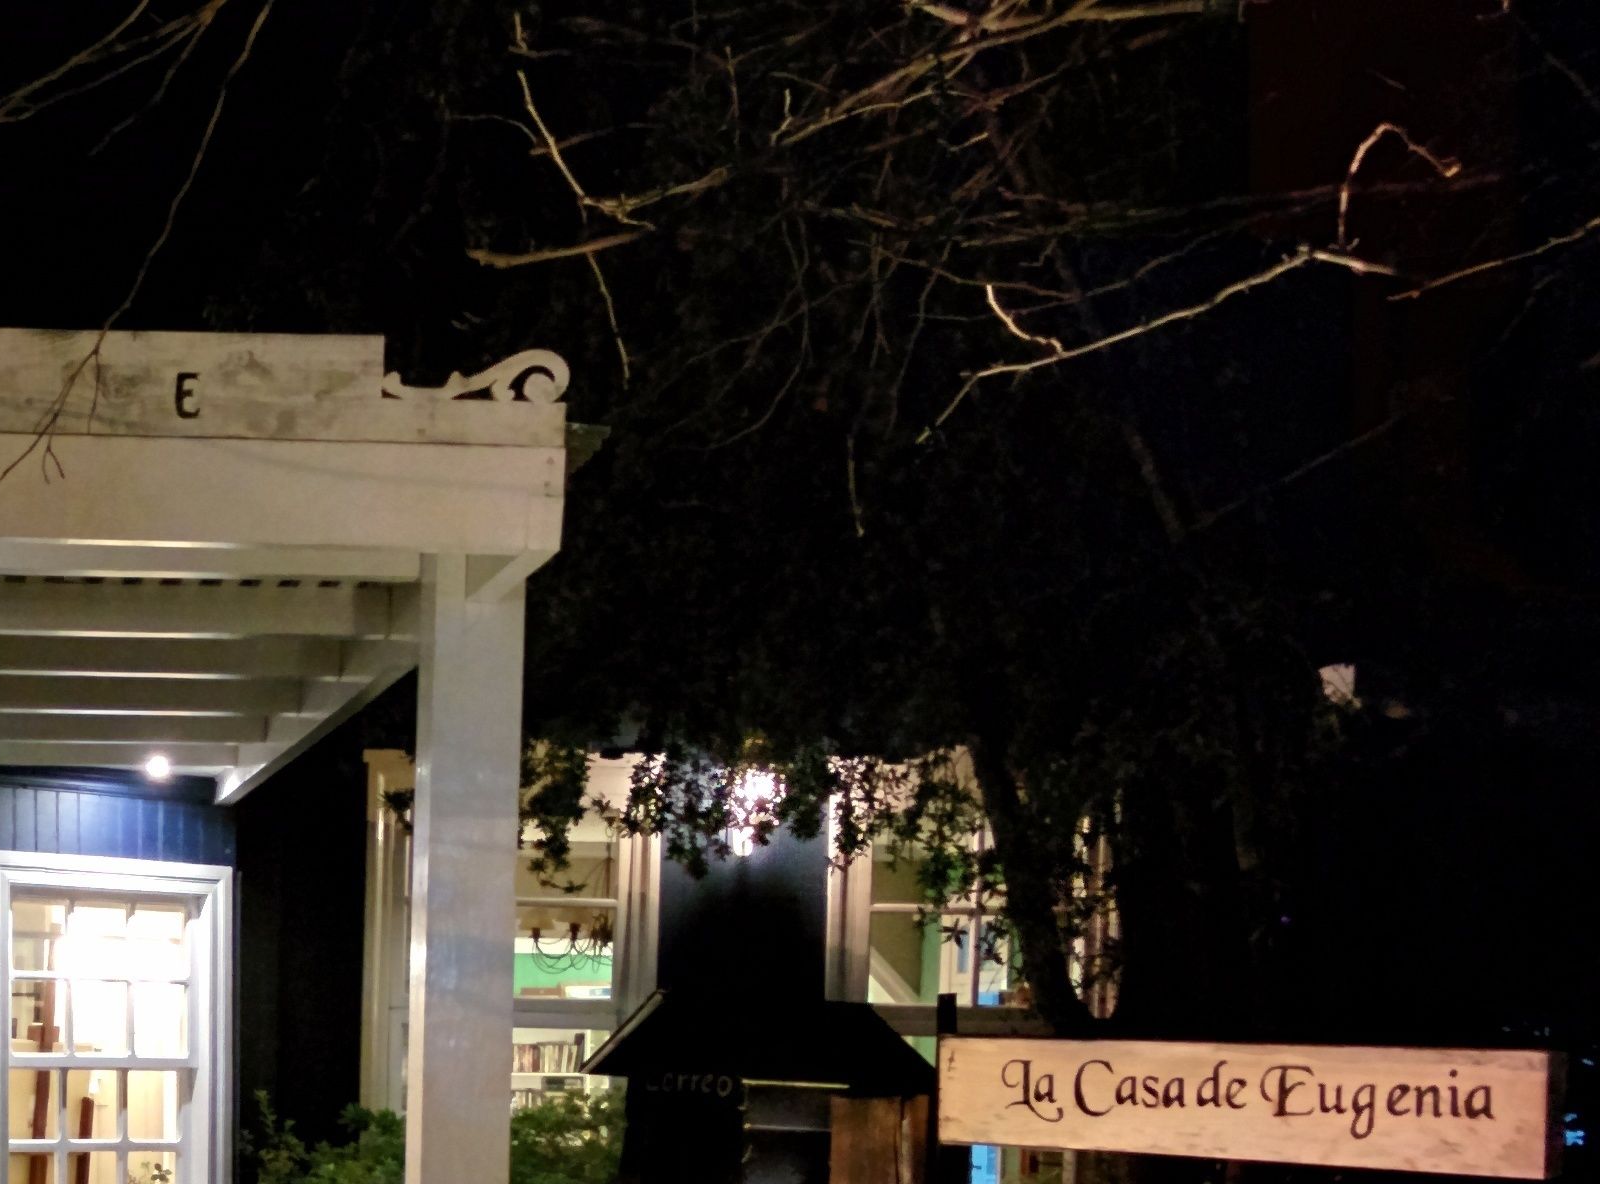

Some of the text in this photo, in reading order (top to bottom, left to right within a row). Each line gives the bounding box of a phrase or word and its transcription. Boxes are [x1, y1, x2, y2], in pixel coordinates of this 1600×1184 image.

[175, 372, 201, 419] E
[1001, 1059, 1495, 1139] La Casa de Eugenia
